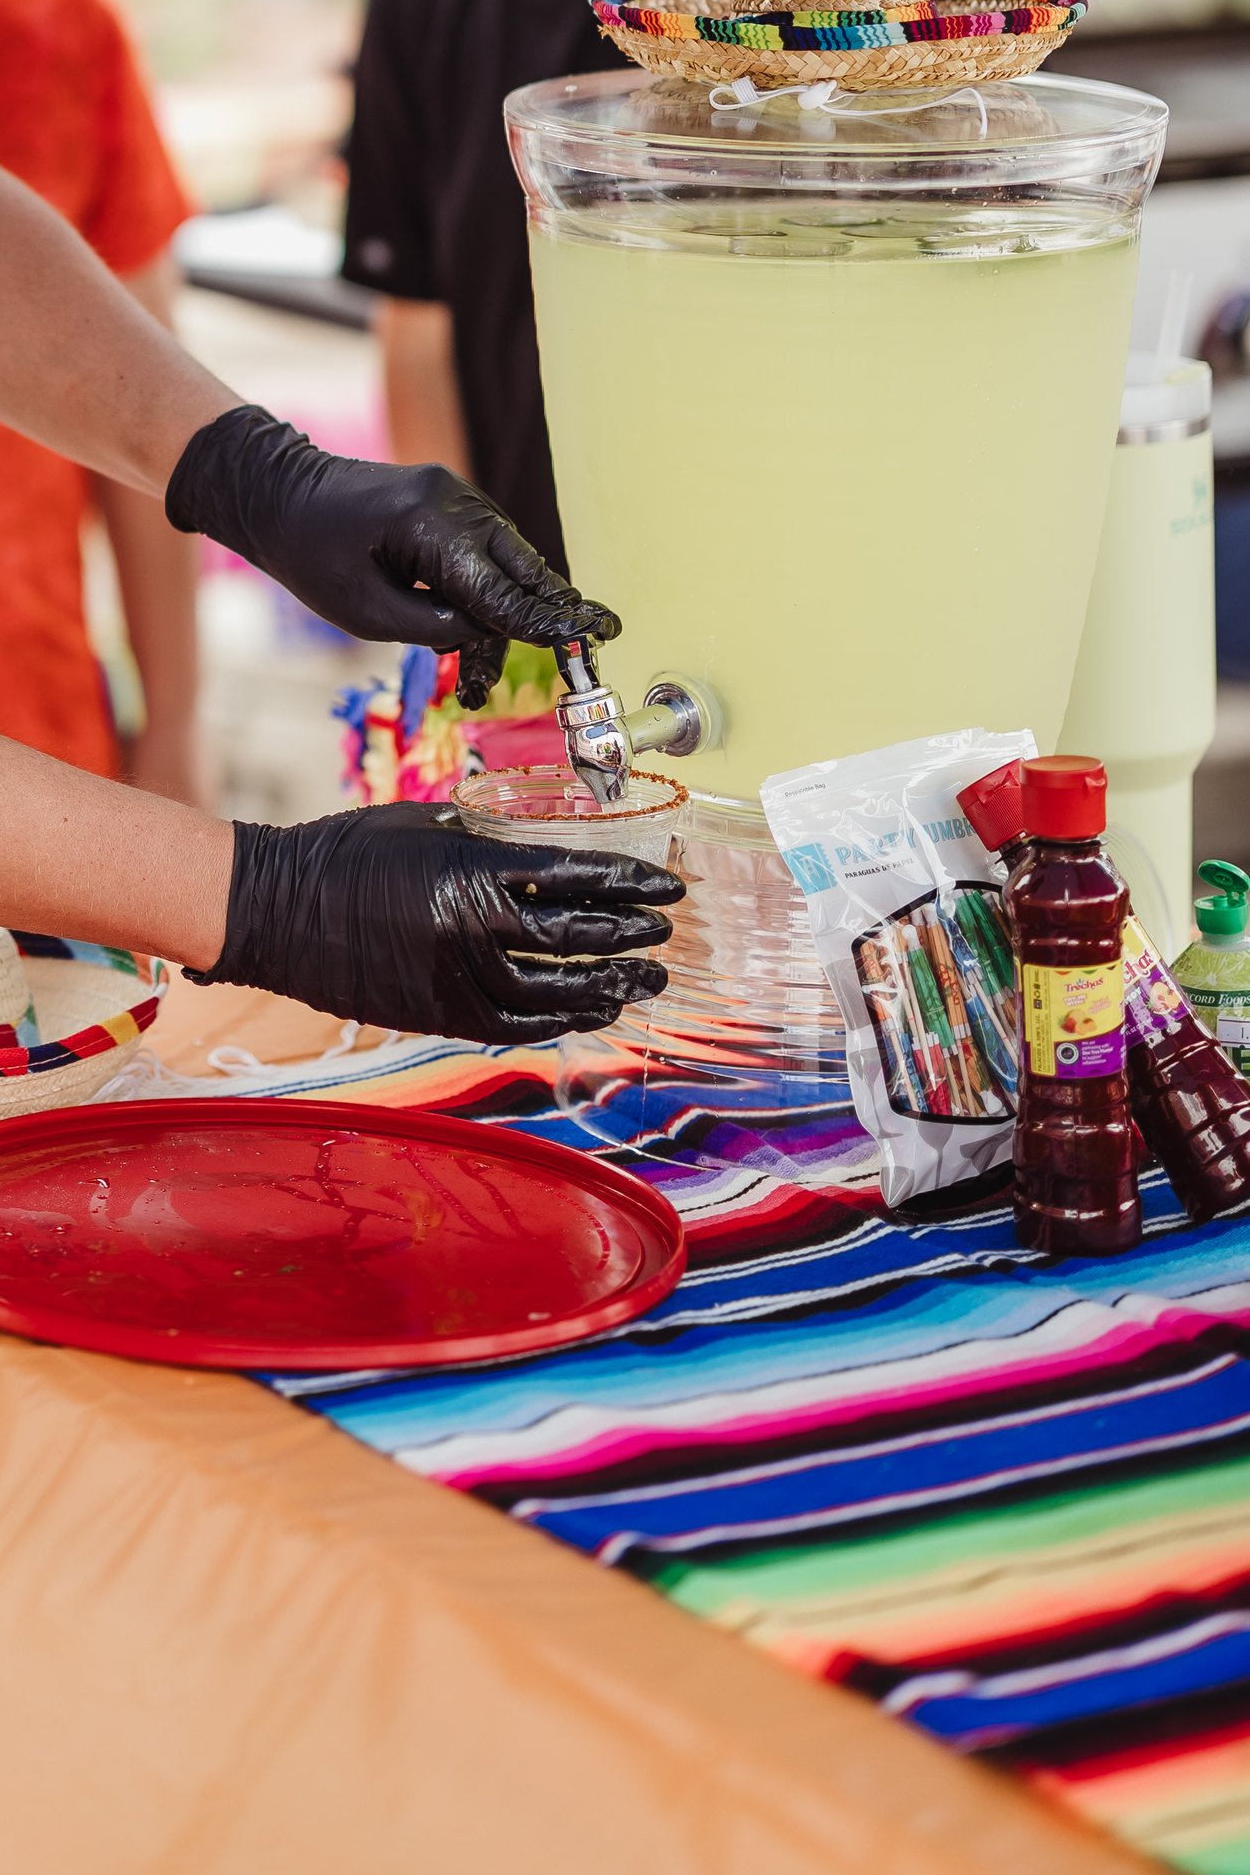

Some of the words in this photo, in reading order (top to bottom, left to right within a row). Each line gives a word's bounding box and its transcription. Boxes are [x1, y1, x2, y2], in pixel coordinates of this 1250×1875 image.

[835, 827, 918, 866] PARTY
[844, 866, 881, 879] PARAGUAS
[1186, 992, 1215, 1004] CORD
